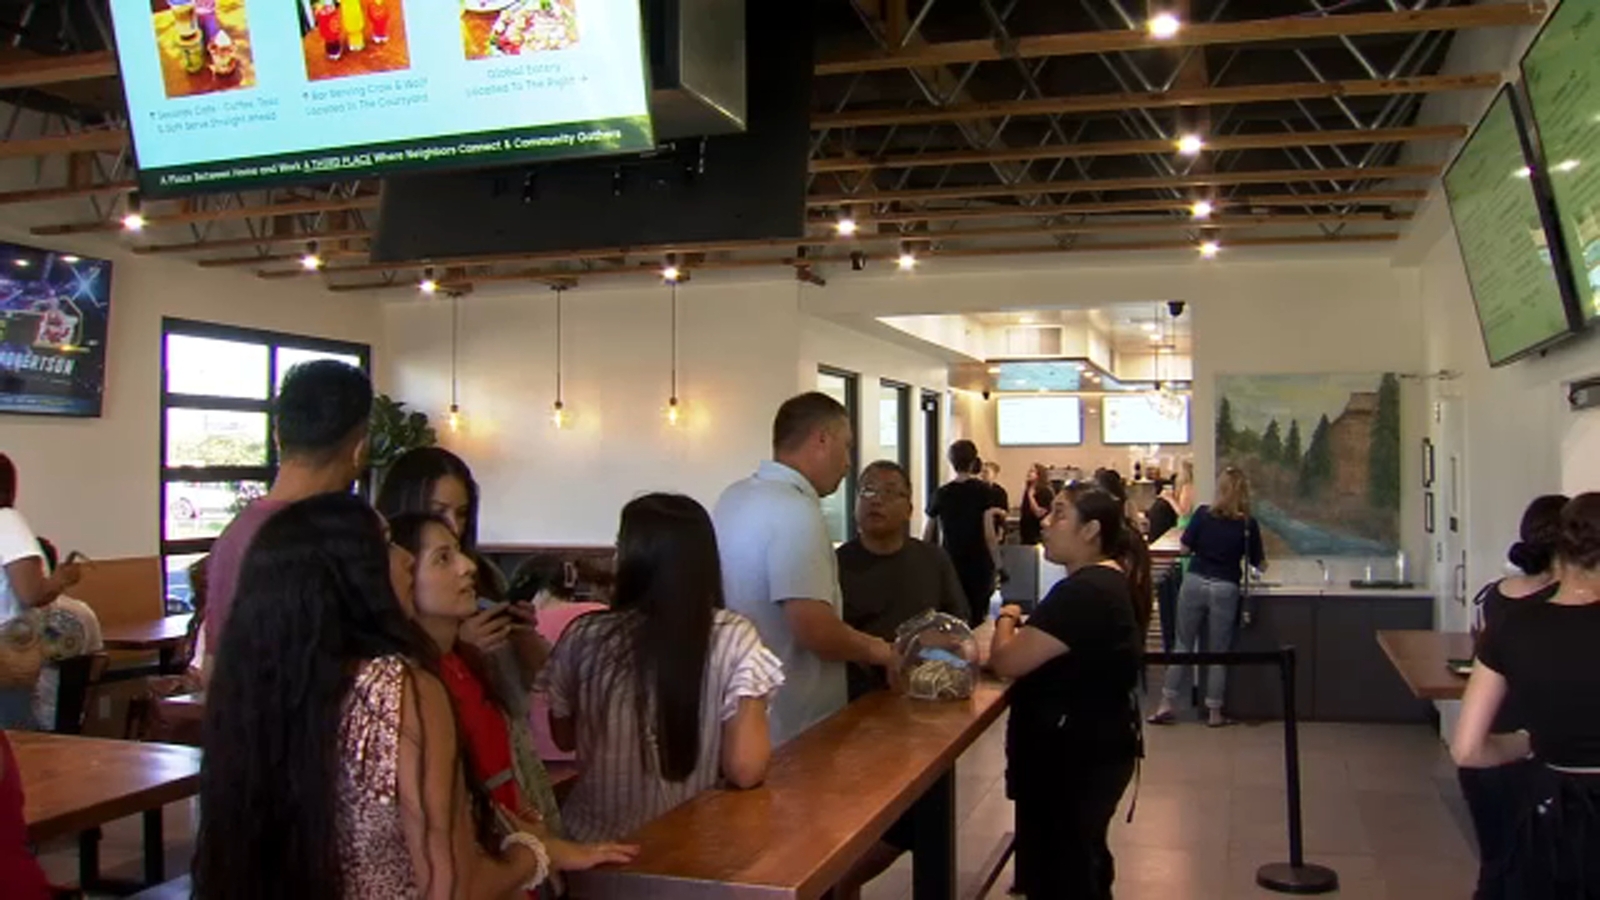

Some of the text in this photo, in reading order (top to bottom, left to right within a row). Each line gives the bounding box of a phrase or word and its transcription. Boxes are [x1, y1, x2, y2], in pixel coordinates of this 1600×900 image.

[404, 146, 457, 161] Neighbors
[458, 141, 502, 154] Connect
[512, 132, 576, 149] Community
[576, 129, 622, 142] Gathers
